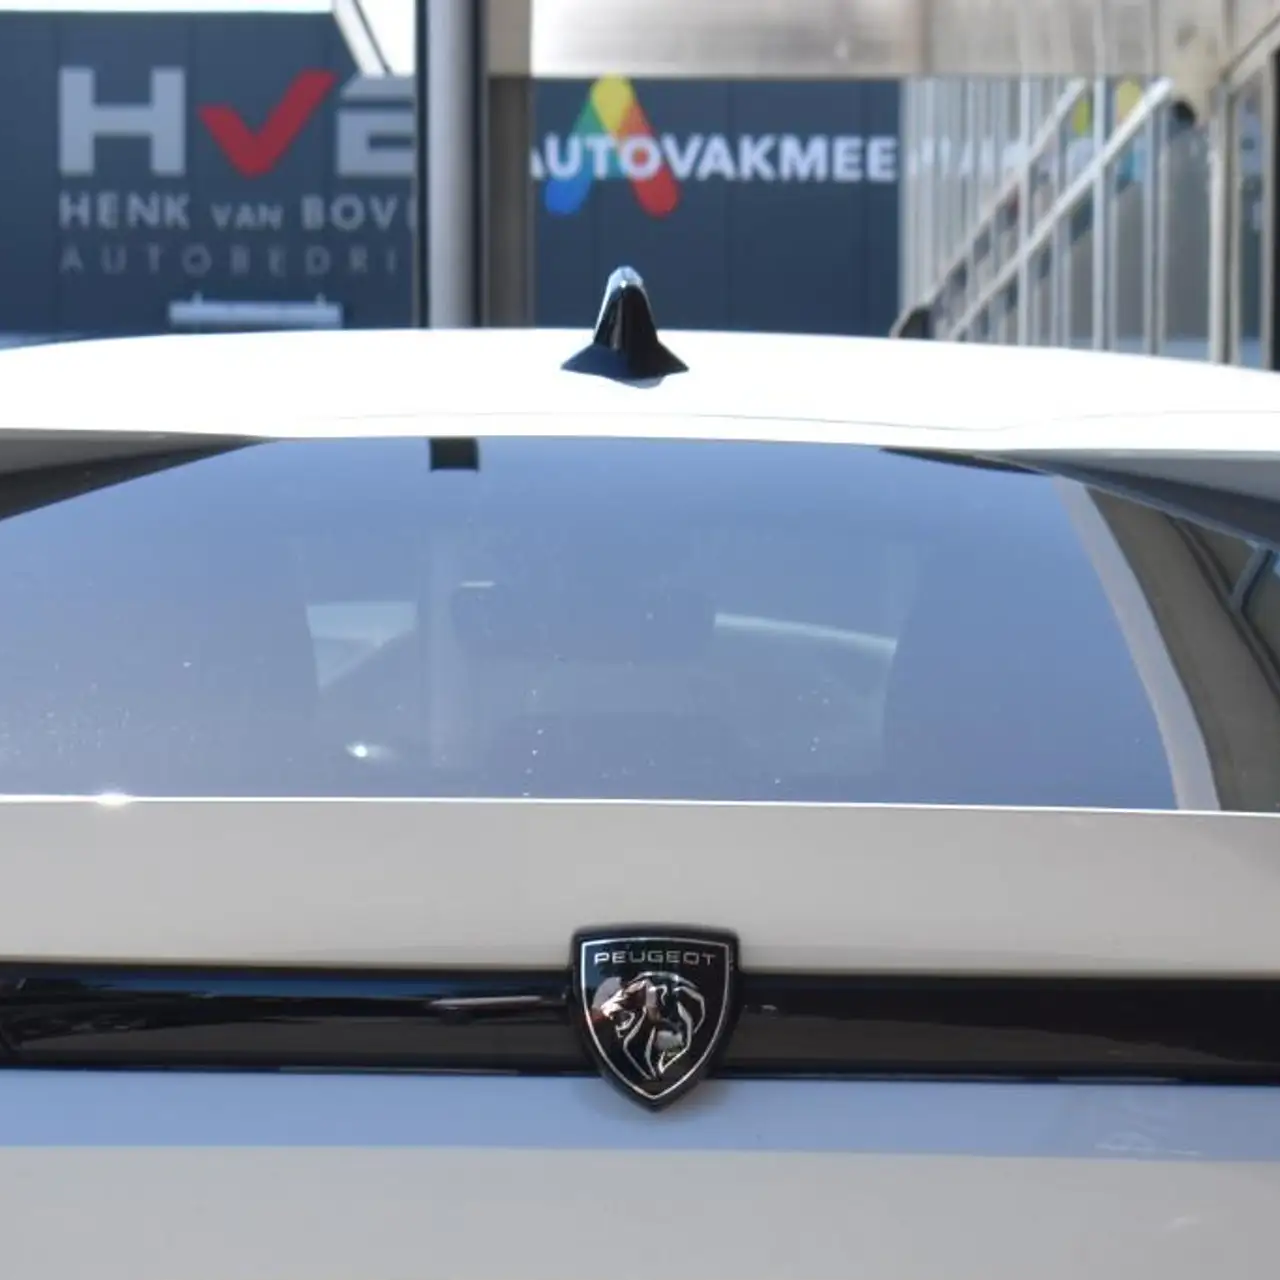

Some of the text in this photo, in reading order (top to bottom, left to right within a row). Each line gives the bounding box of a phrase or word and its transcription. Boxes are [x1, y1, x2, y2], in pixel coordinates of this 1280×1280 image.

[58, 191, 415, 231] HENK VAN BOV
[593, 950, 716, 966] PEUGEOT
